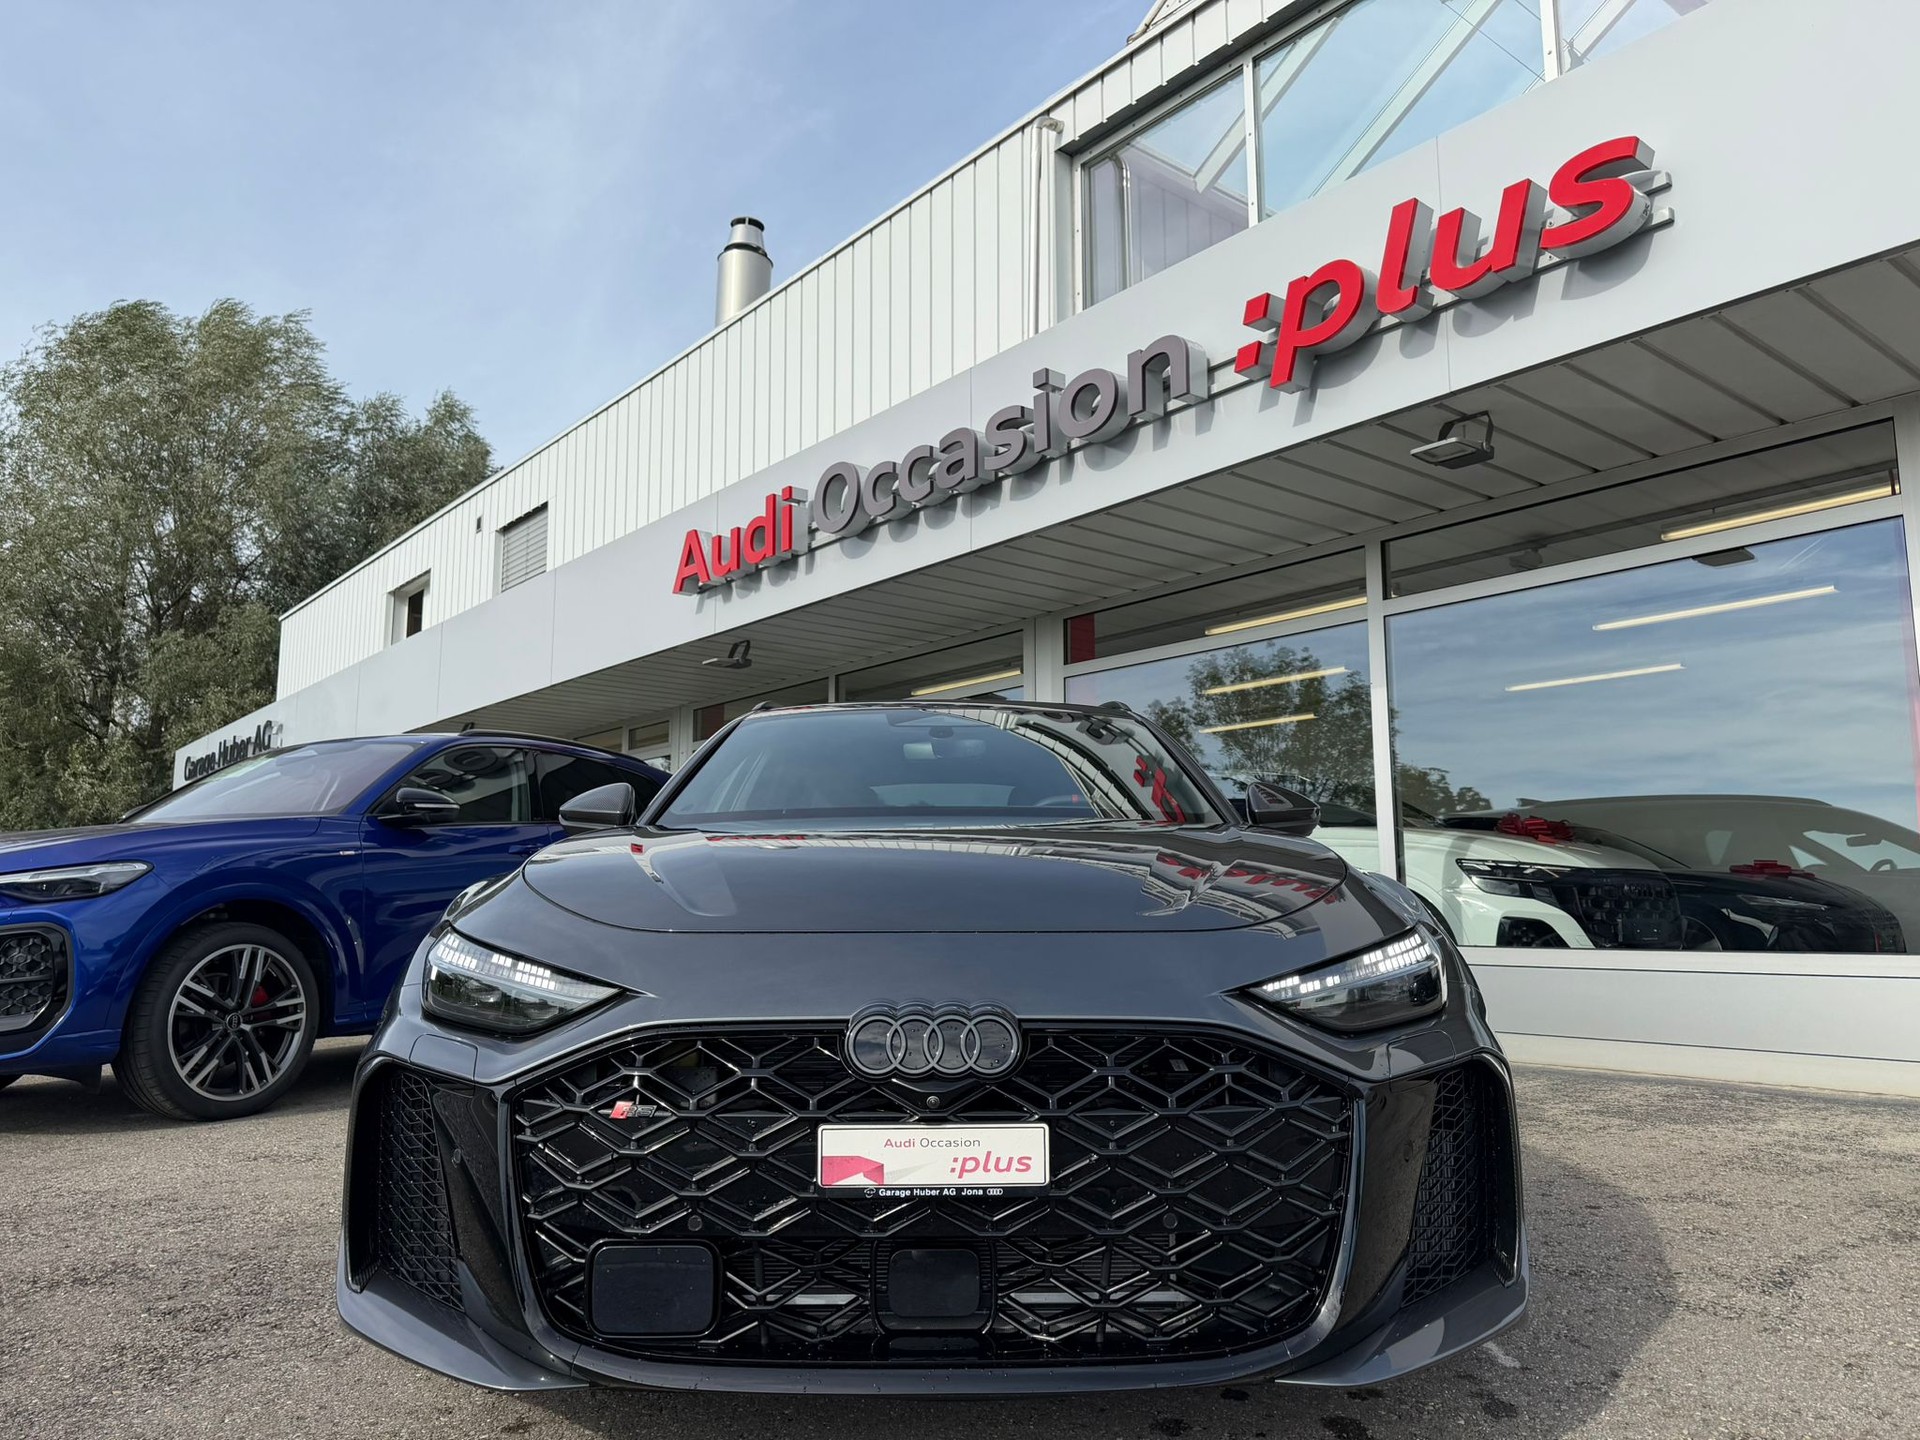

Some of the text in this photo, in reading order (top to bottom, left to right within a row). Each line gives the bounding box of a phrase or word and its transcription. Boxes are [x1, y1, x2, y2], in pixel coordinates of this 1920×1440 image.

[672, 136, 1644, 595] Audi Occasion :plus
[184, 720, 273, 781] Garage Huber AG
[884, 1137, 981, 1148] Audi Occasion
[949, 1151, 1033, 1179] :plus
[879, 1188, 984, 1197] Garage Huber AG Jona
